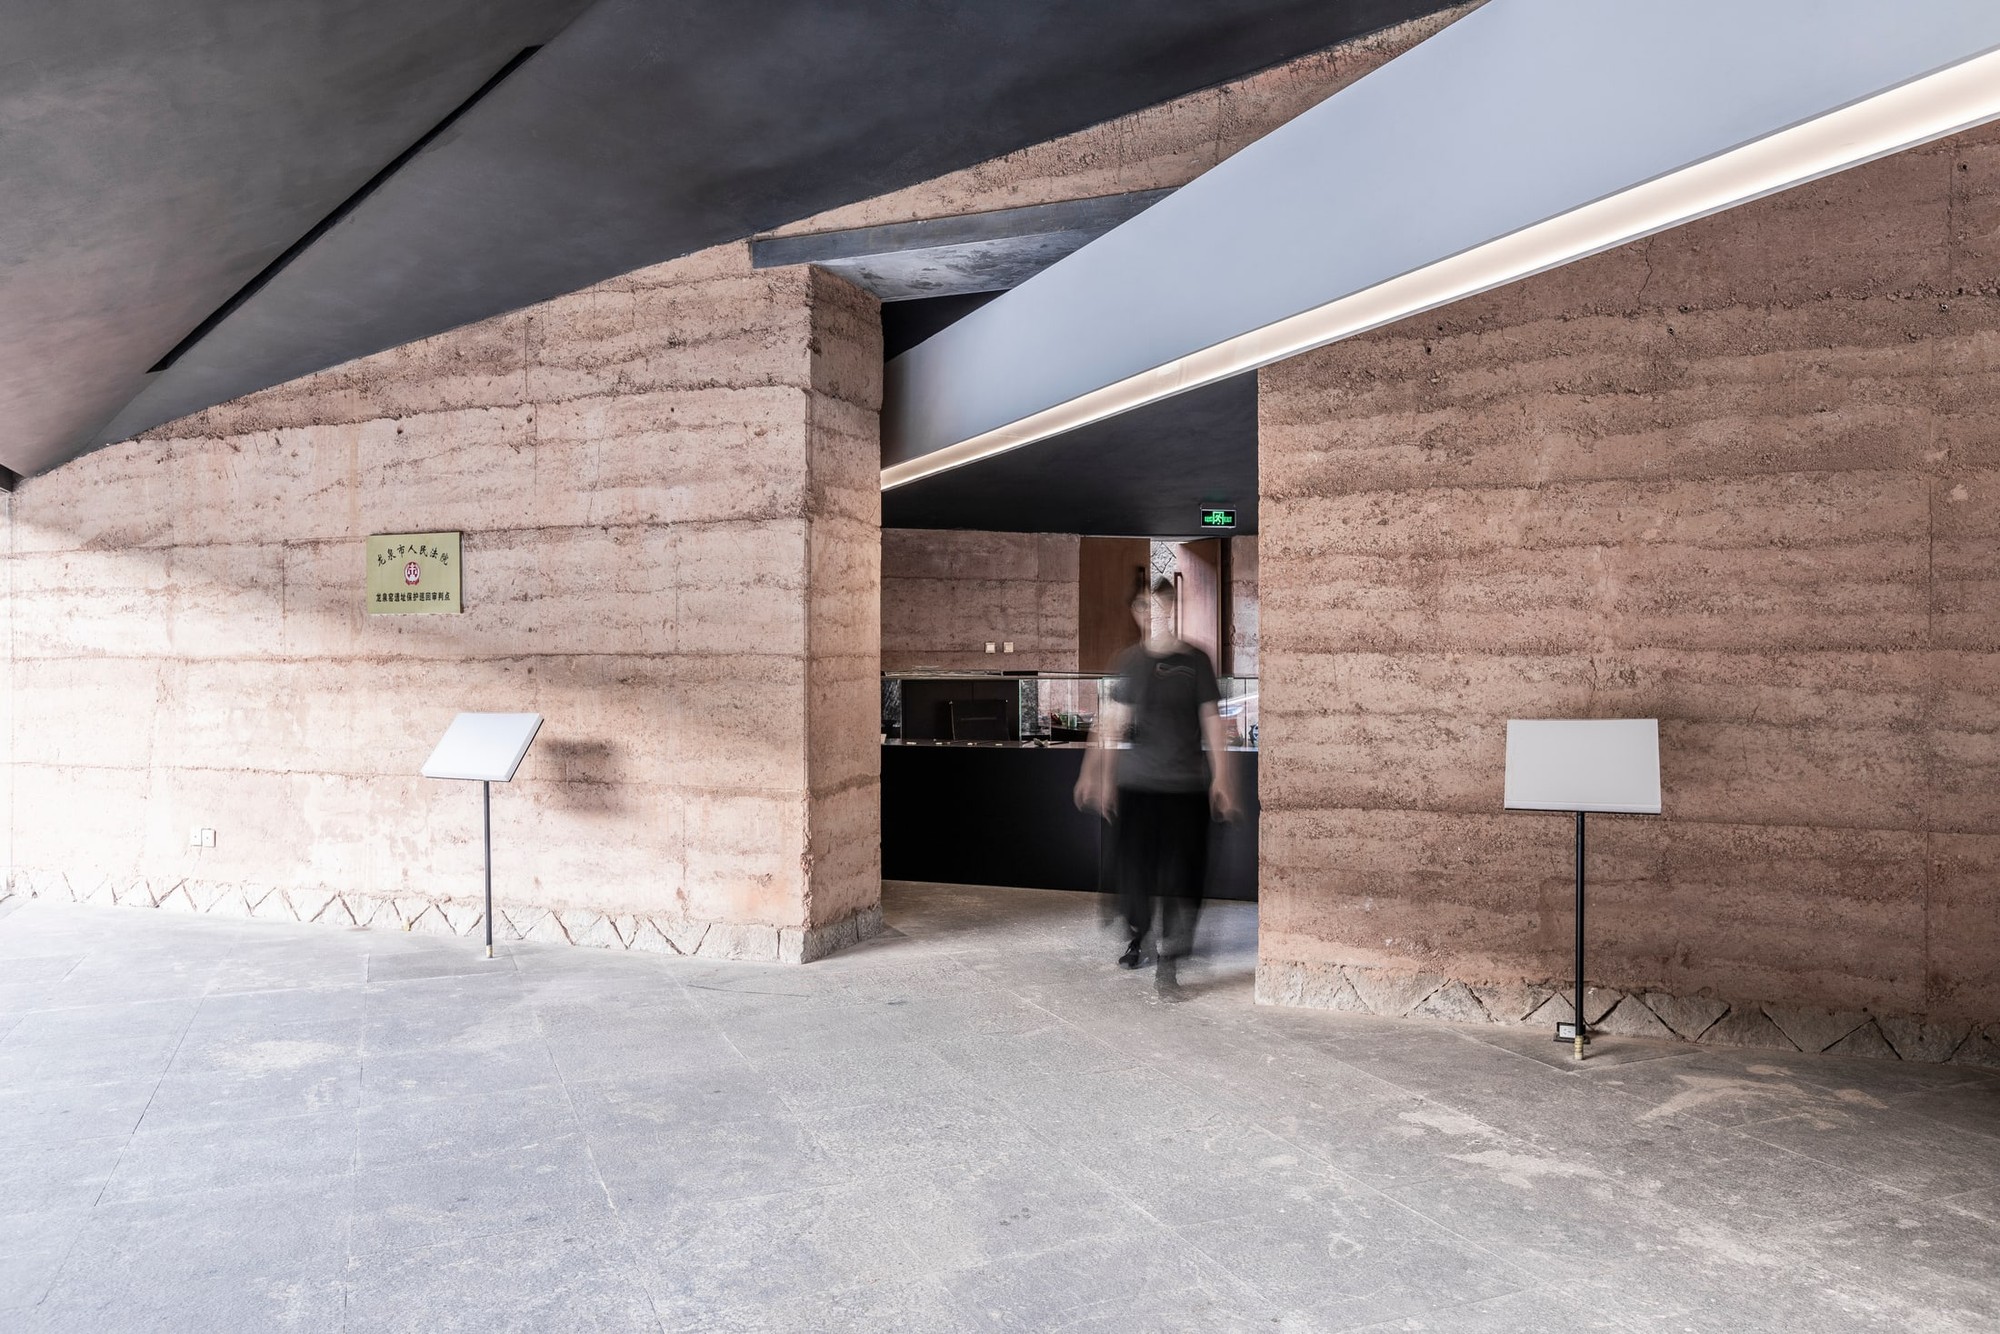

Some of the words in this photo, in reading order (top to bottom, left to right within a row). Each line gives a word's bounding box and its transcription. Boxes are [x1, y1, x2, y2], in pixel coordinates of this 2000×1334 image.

[377, 544, 449, 566] 龙泉市人民法院
